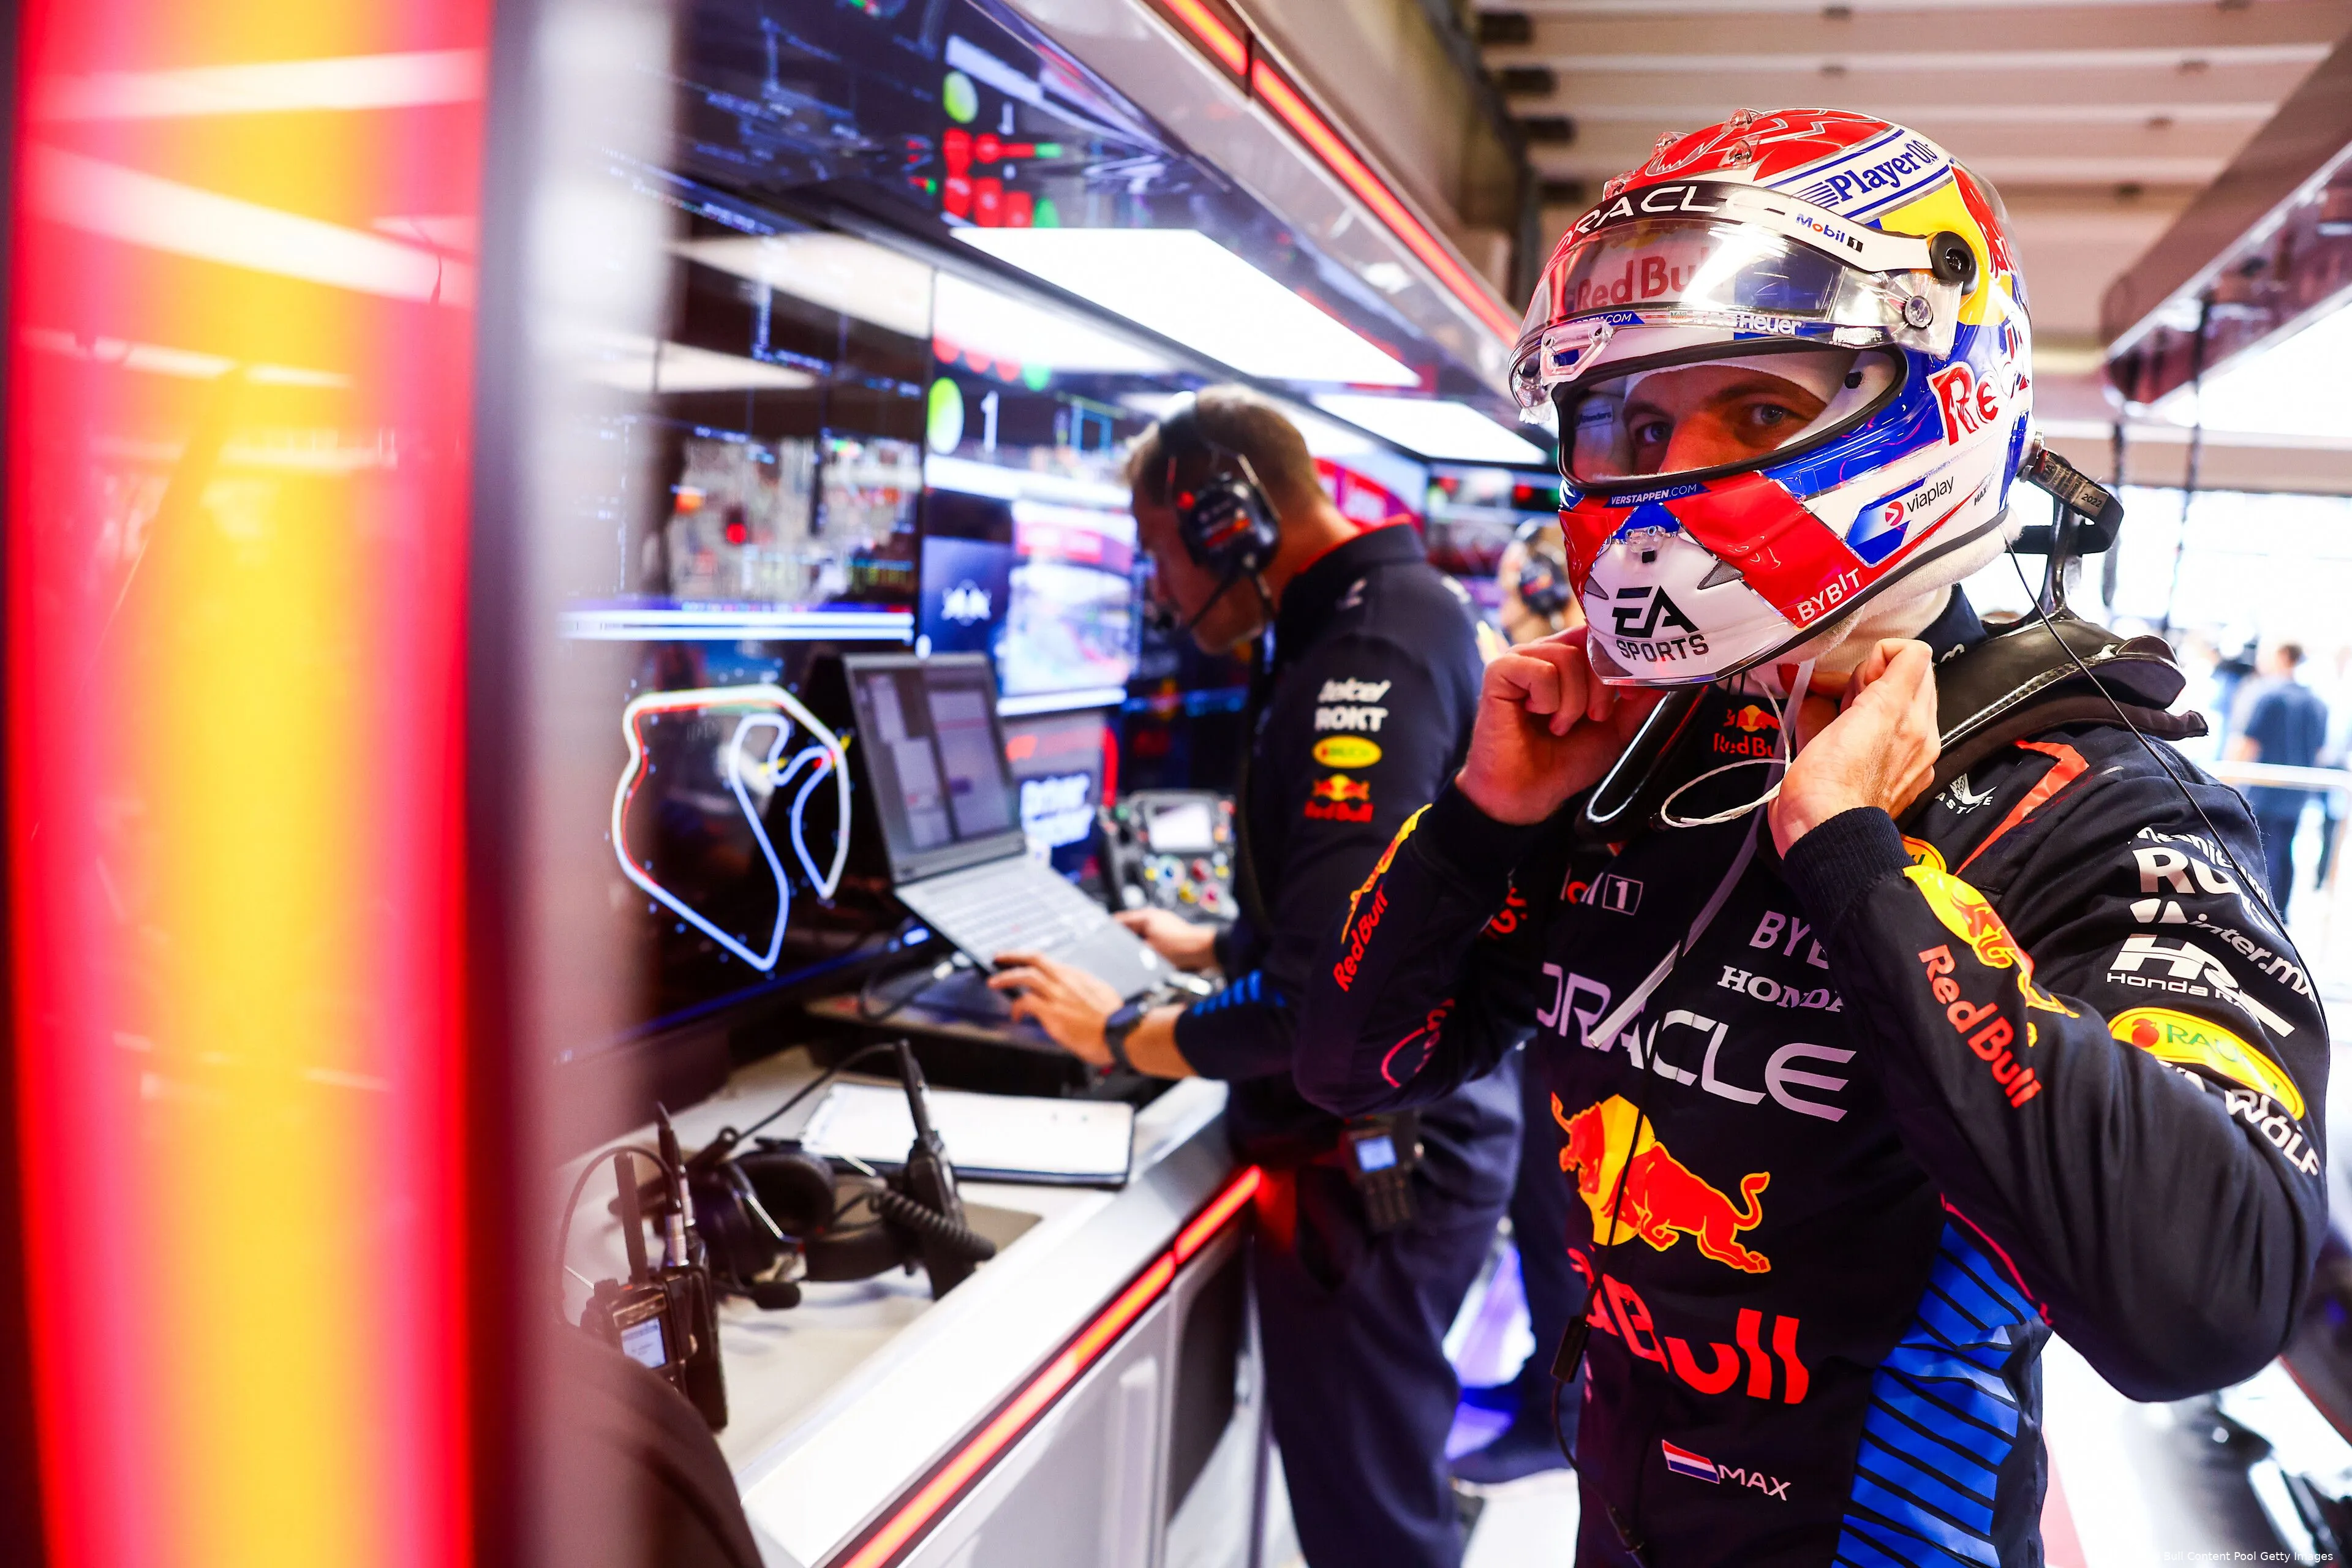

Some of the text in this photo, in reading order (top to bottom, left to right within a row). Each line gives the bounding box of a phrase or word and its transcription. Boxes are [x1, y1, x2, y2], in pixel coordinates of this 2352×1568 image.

[1795, 214, 1845, 243] Mobil
[1577, 247, 1712, 310] Red Bu
[1739, 314, 1803, 336] Heuer
[981, 390, 1000, 453] 1
[1611, 483, 1697, 505] VERSTAPPEN.COM
[1907, 476, 1954, 513] viaplay
[2081, 493, 2103, 508] 2022
[1612, 586, 1700, 638] EA
[1796, 567, 1861, 622] BYBIT
[1616, 634, 1709, 662] SPORTS
[1714, 733, 1774, 758] Red Bu
[1333, 883, 1389, 992] Red Bull
[1749, 910, 1830, 970] BYB
[2106, 972, 2209, 997] Honda
[1536, 962, 1857, 1123] ORACLE
[1918, 944, 2043, 1109] Red Bull
[2225, 1090, 2321, 1176] WOLF
[1602, 1273, 1809, 1404] Bull
[1717, 1464, 1792, 1501] MAX
